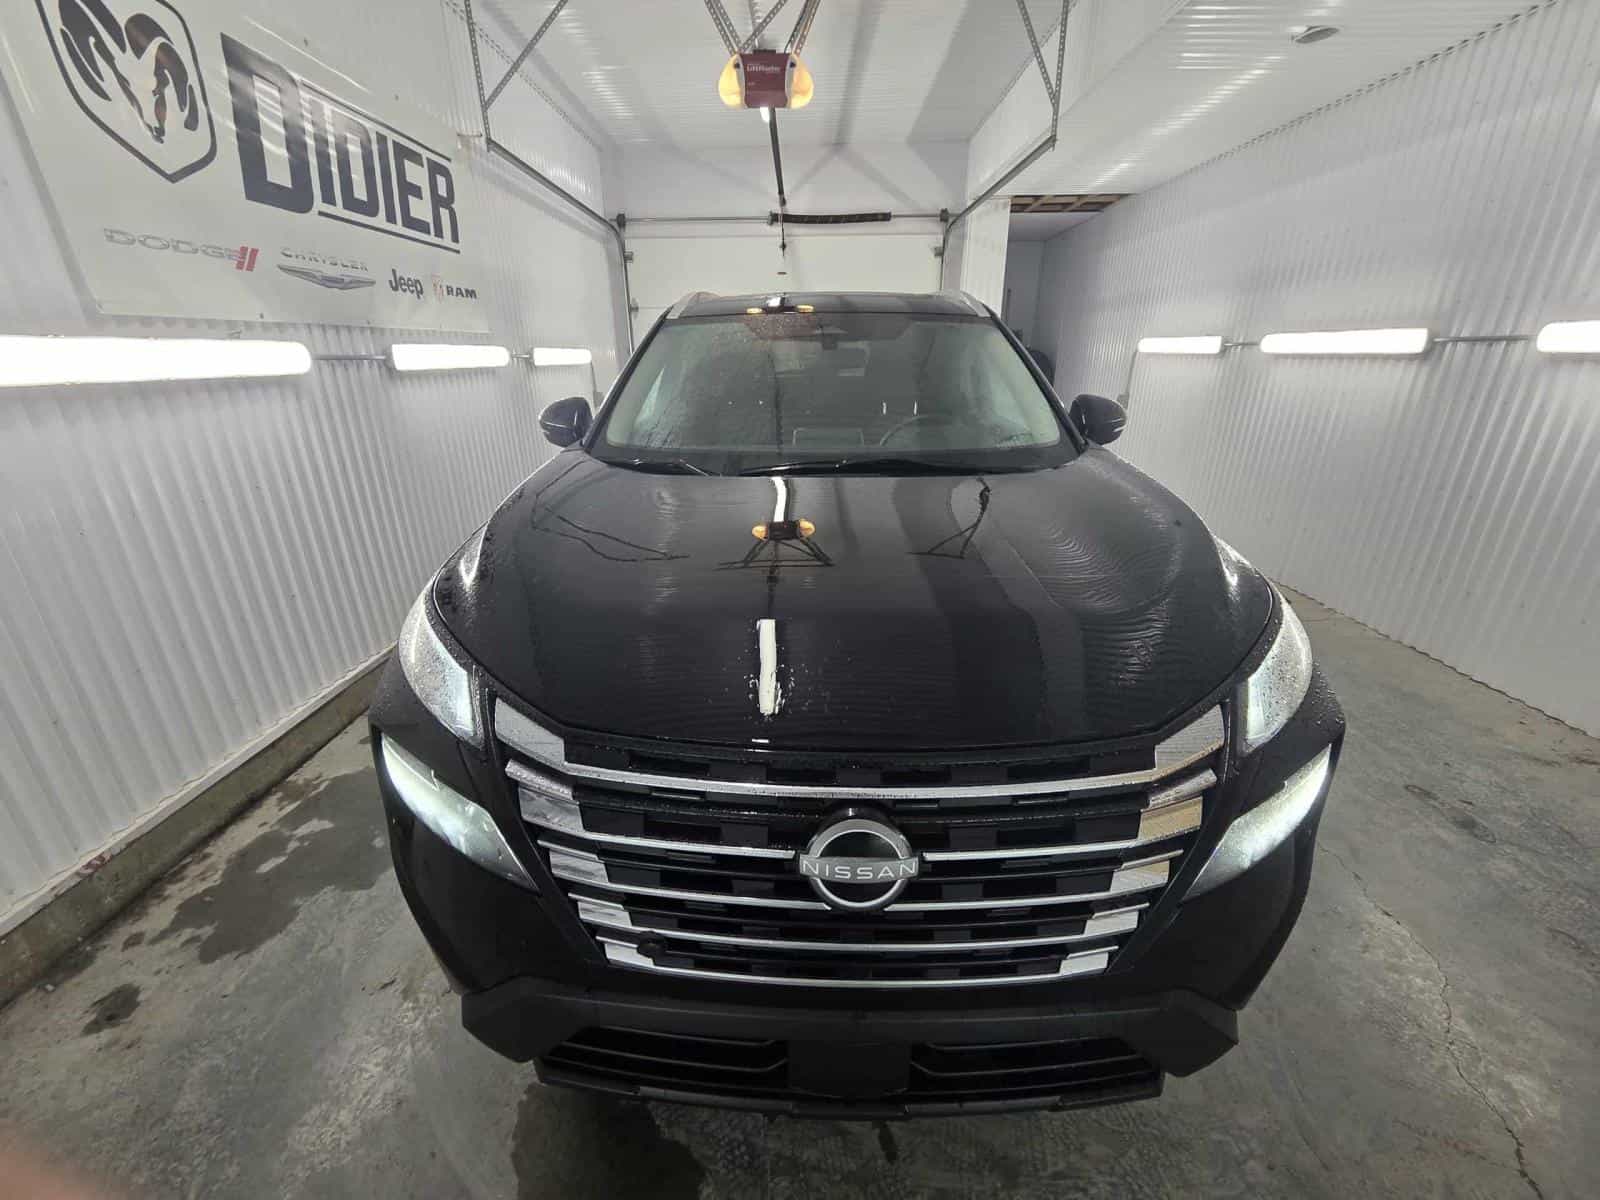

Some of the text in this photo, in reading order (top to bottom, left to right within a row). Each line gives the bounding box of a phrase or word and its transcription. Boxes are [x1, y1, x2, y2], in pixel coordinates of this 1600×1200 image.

[220, 32, 460, 244] DIDIER
[388, 268, 424, 300] Jeep
[446, 286, 477, 299] RAM
[802, 859, 917, 880] NISSAN
